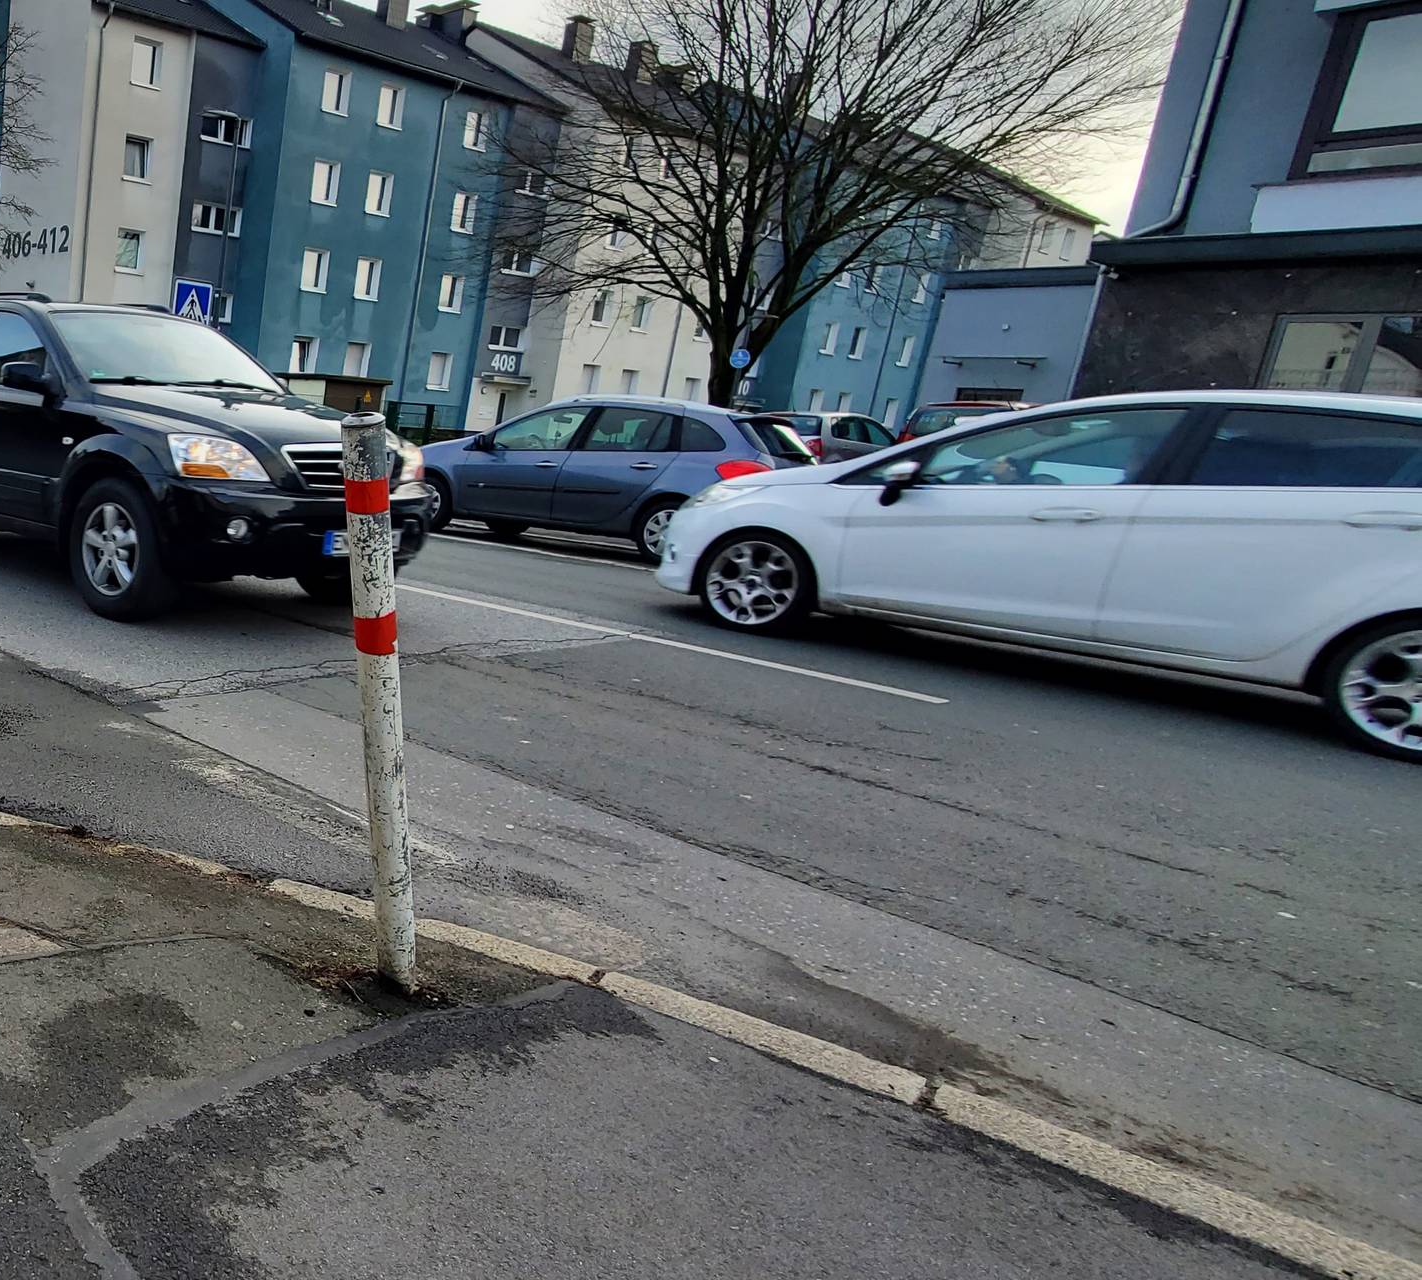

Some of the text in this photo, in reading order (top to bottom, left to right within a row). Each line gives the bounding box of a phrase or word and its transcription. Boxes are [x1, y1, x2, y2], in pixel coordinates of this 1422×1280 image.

[2, 225, 70, 259] 406-412
[490, 353, 517, 372] 408
[738, 380, 750, 396] 10
